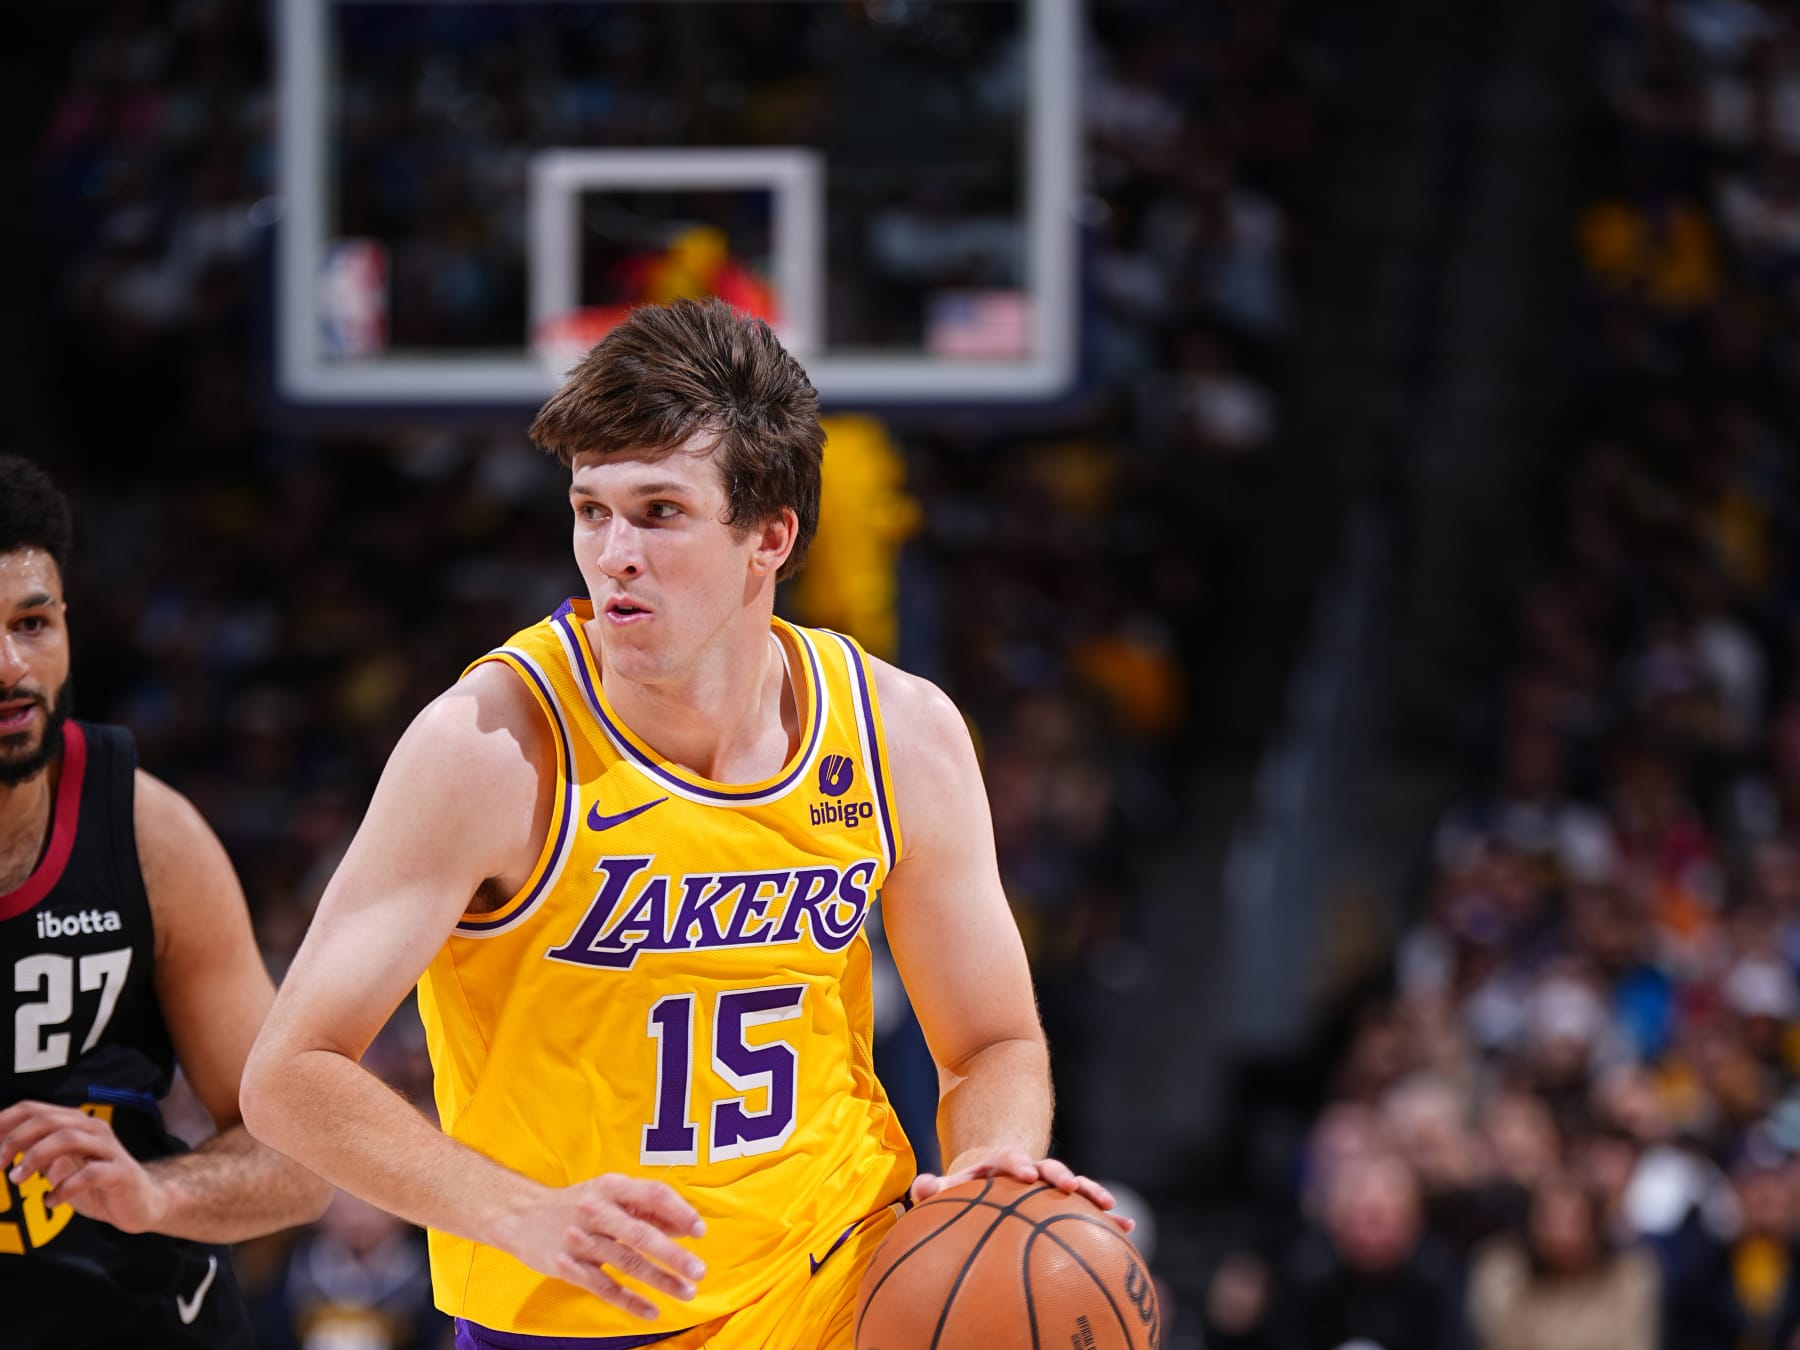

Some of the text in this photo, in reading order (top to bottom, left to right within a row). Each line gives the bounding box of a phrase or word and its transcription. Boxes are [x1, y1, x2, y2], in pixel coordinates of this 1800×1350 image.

[809, 800, 874, 828] bibigo
[36, 908, 122, 939] ibotta
[543, 853, 880, 970] LAKERS
[14, 947, 133, 1074] 27
[640, 982, 809, 1166] 15
